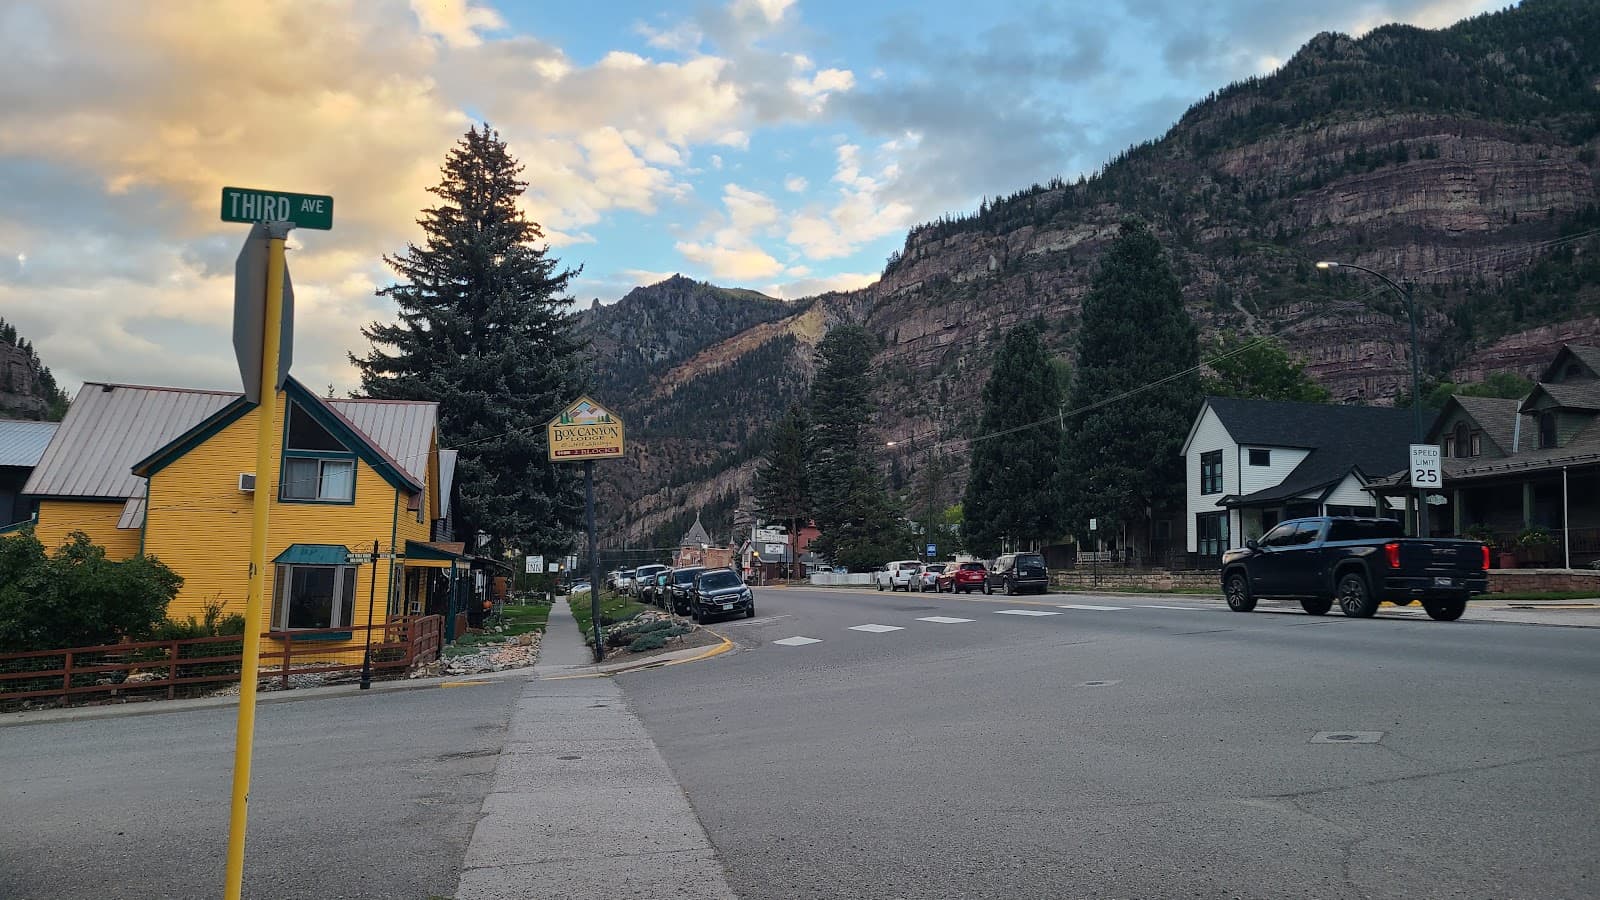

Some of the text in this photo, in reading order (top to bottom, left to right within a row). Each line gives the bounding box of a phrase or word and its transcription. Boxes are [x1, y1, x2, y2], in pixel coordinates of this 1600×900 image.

[230, 192, 324, 222] THIRD AVE
[554, 427, 618, 442] BOX CANYON
[1416, 469, 1437, 482] 25
[528, 563, 542, 572] INN
